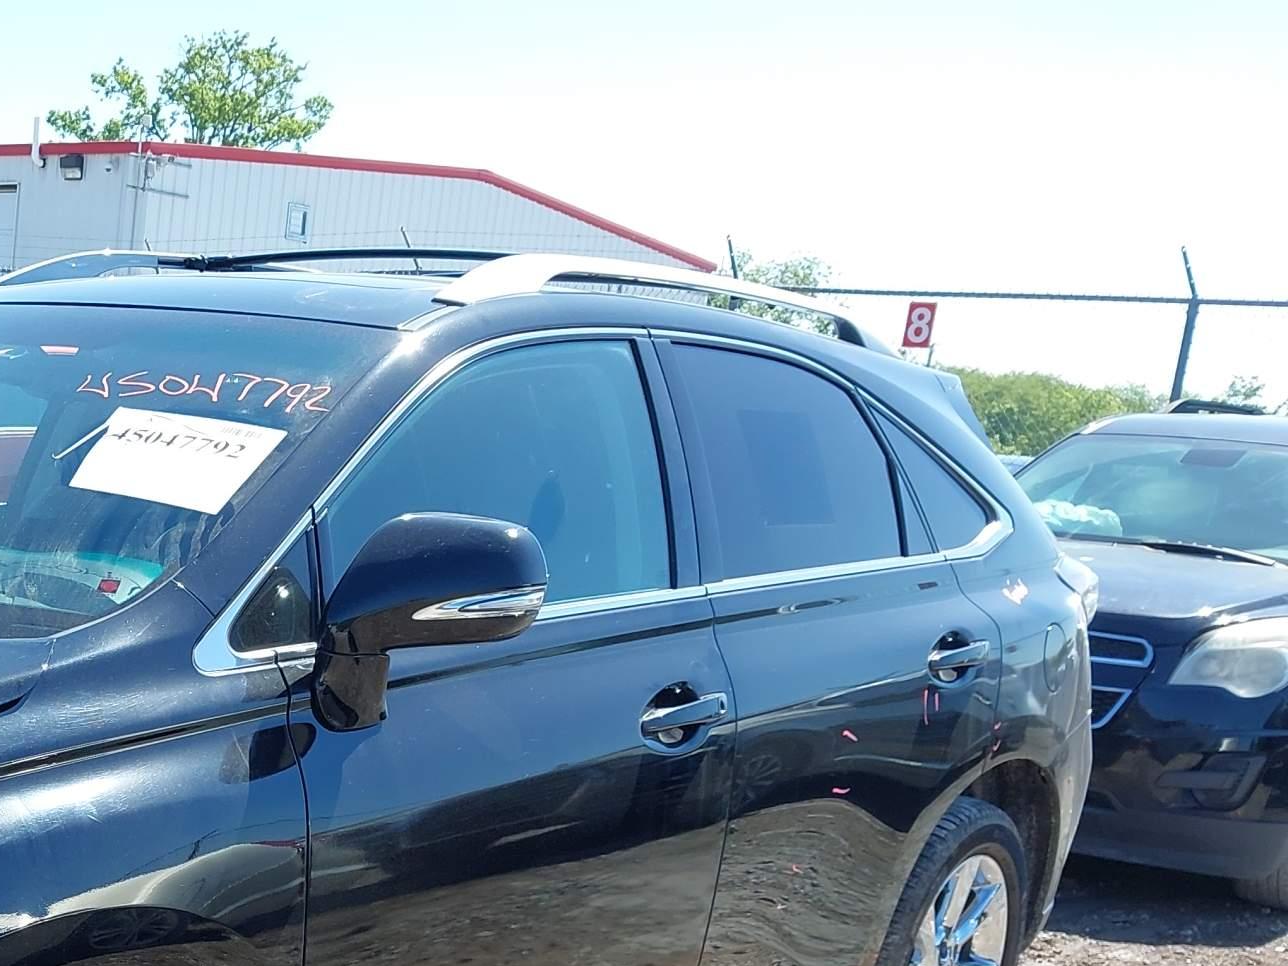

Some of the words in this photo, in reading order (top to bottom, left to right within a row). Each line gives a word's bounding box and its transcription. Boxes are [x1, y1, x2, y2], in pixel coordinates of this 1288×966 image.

[906, 307, 932, 344] 8
[76, 370, 332, 414] 45047792
[105, 427, 247, 459] 45047792
